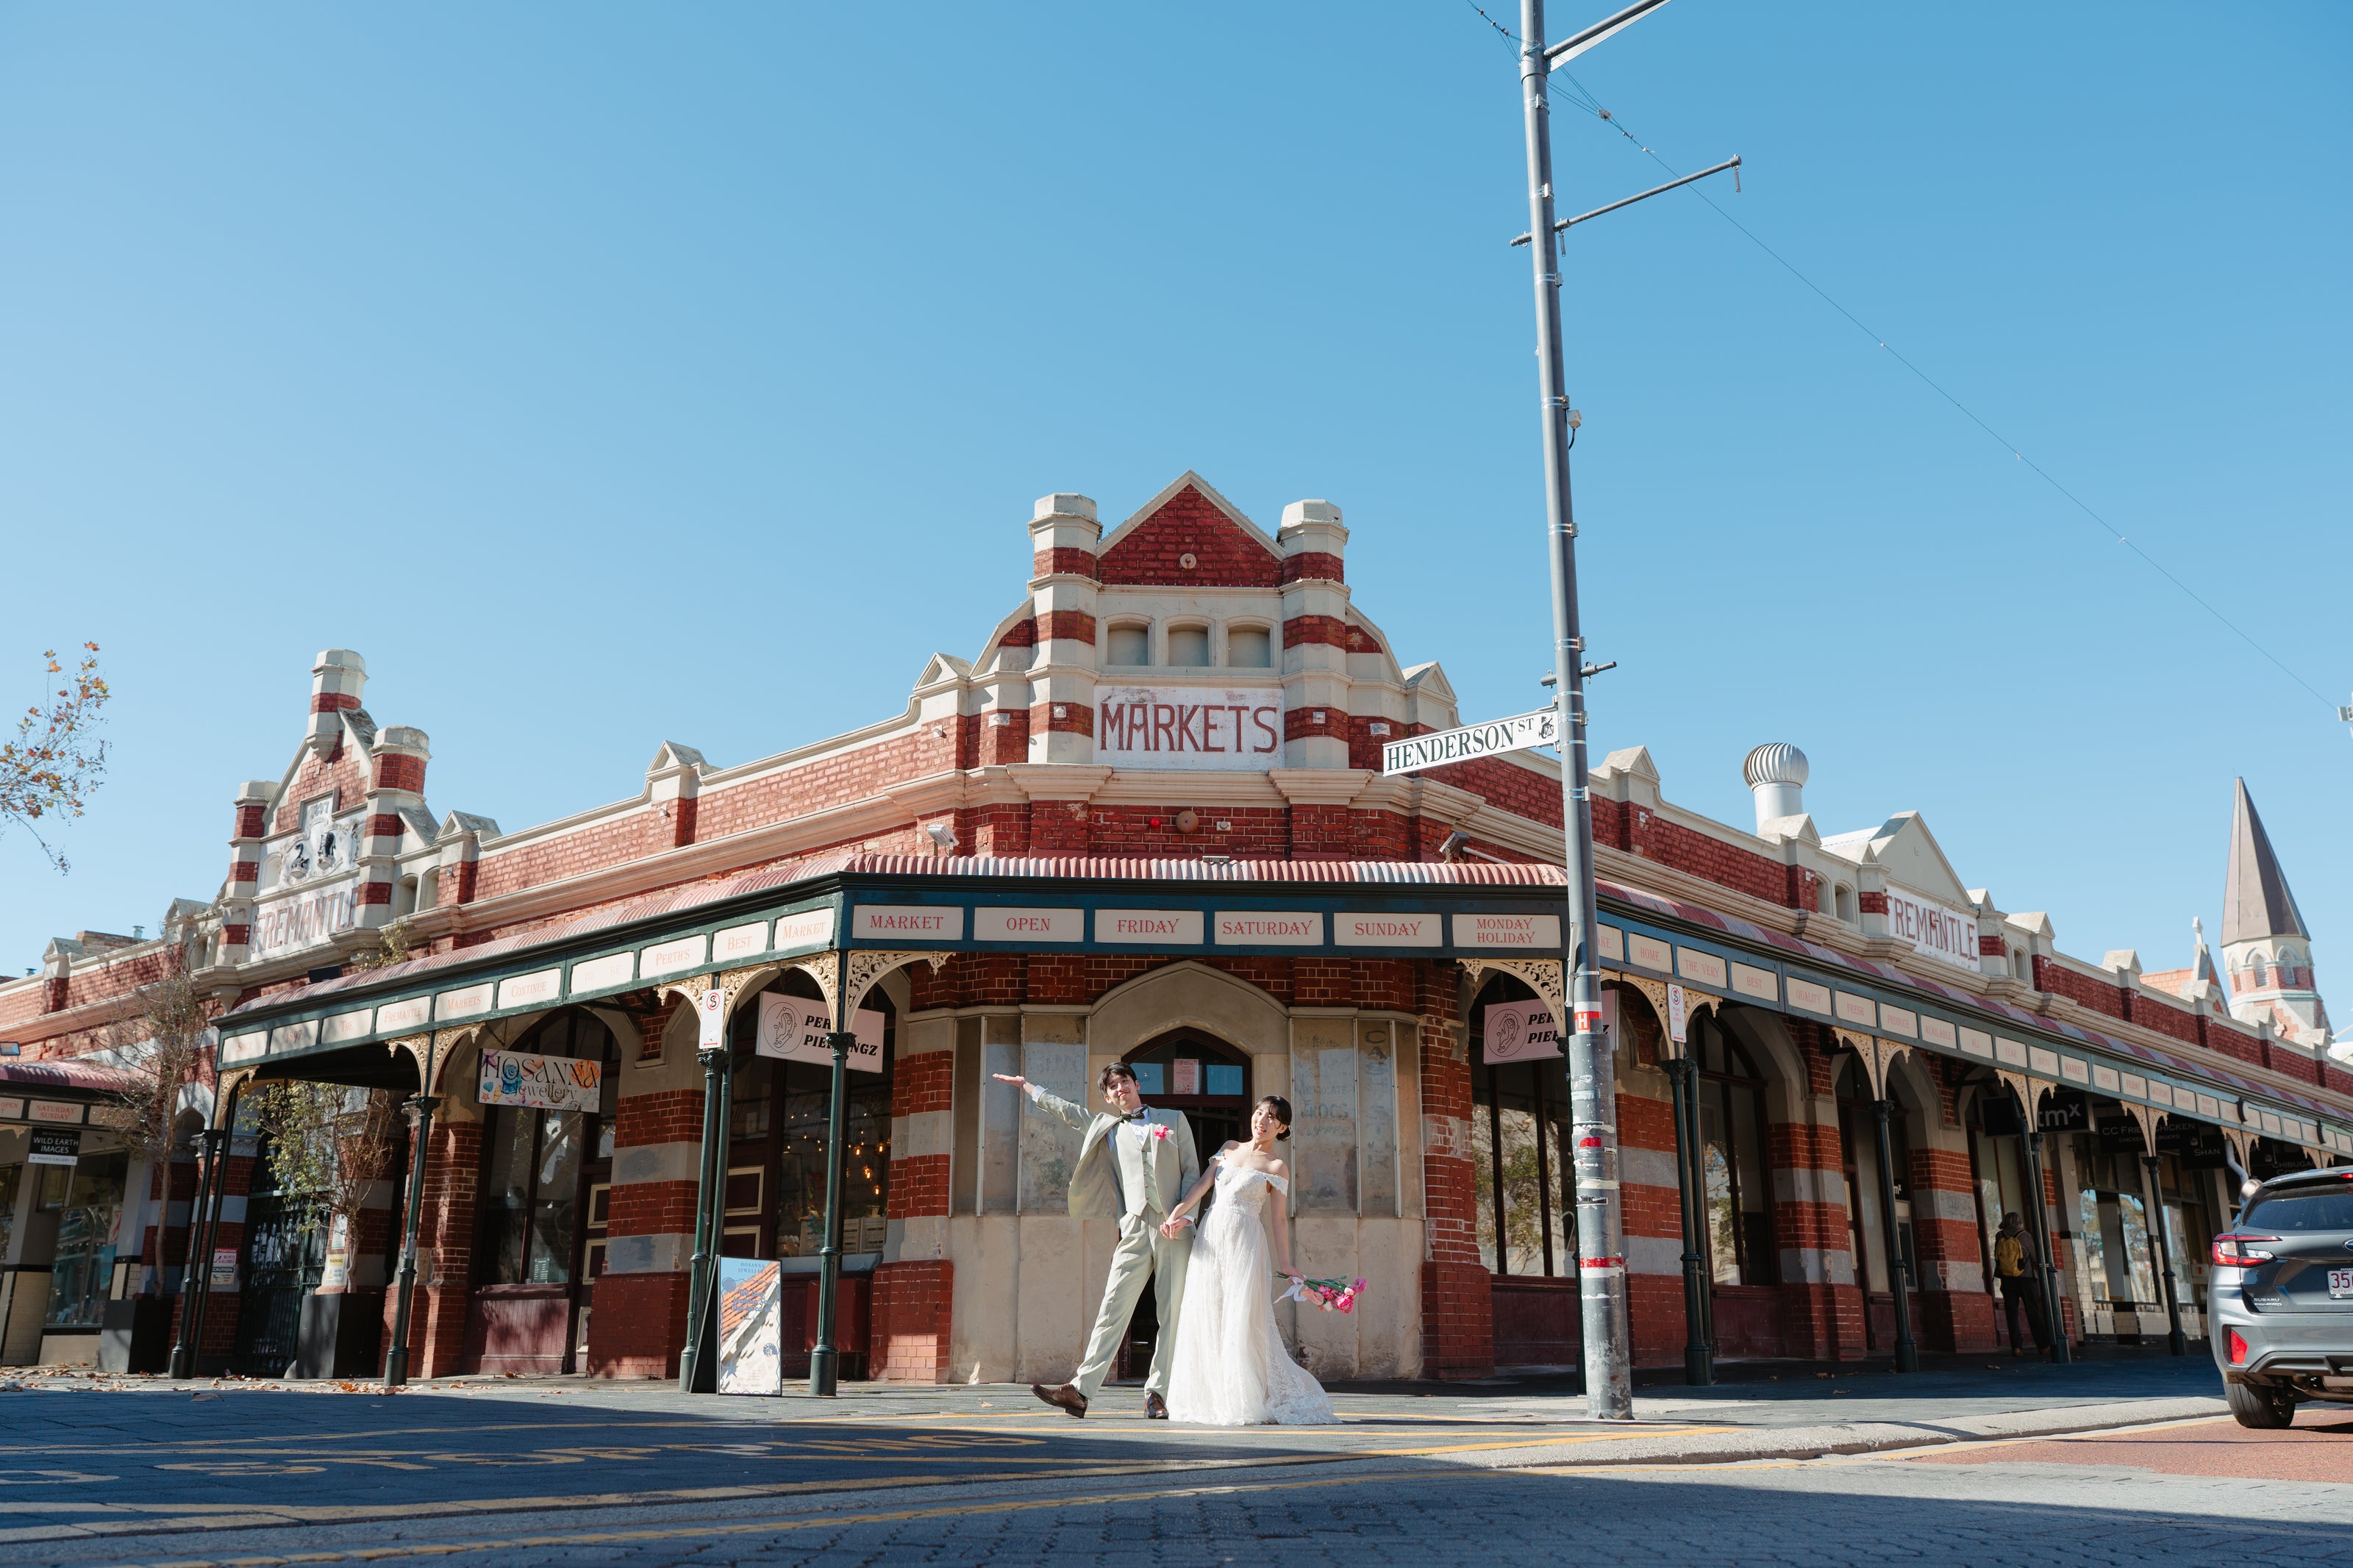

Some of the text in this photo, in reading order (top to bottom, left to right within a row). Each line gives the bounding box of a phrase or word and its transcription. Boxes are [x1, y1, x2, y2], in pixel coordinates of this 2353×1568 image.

[1100, 703, 1277, 753] MARKETS
[1387, 717, 1534, 771] HENDERSON ST
[250, 887, 359, 954] FREMANTLE
[871, 914, 944, 931] MARKET
[1006, 917, 1051, 931] OPEN
[1117, 917, 1179, 934] FRIDAY
[1222, 919, 1313, 937] SATURDAY
[1477, 917, 1533, 931] MONDAY
[782, 922, 826, 939] MARKET
[1354, 920, 1423, 937] SUNDAY
[727, 936, 752, 951] BEST
[1477, 931, 1536, 945] HOLIDAY
[1597, 936, 1611, 949] AKE
[1640, 947, 1660, 962] HOME
[1685, 959, 1720, 978] THE VERY
[511, 981, 547, 998] CONTINUE
[1746, 976, 1762, 989] BEST
[447, 995, 481, 1011] MARKETS
[1796, 989, 1821, 1005] QUALITY
[1846, 1003, 1865, 1017] FRESH
[805, 1015, 832, 1029] PER
[1578, 1013, 1587, 1028] H
[1887, 1014, 1910, 1029] PRODUCE
[1925, 1025, 1952, 1040] AVAILABLE
[1971, 1038, 1980, 1049] ALL
[2004, 1047, 2018, 1059] YEAR
[483, 1055, 599, 1088] HOSANNA
[2065, 1062, 2083, 1076] MARKET
[2101, 1073, 2112, 1084] OPEN
[2126, 1079, 2140, 1092] FRIDAY
[515, 1081, 577, 1100] Jewellery
[36, 1105, 76, 1114] SATURDAY
[40, 1112, 70, 1120] SUNDAY
[2023, 1103, 2081, 1128] tmx
[2102, 1127, 2118, 1135] CC
[2121, 1125, 2142, 1134] FRIE
[33, 1136, 79, 1146] WILD EARTH
[40, 1145, 69, 1153] IMAGES
[2194, 1148, 2220, 1156] SHAN
[2330, 1272, 2353, 1289] 35
